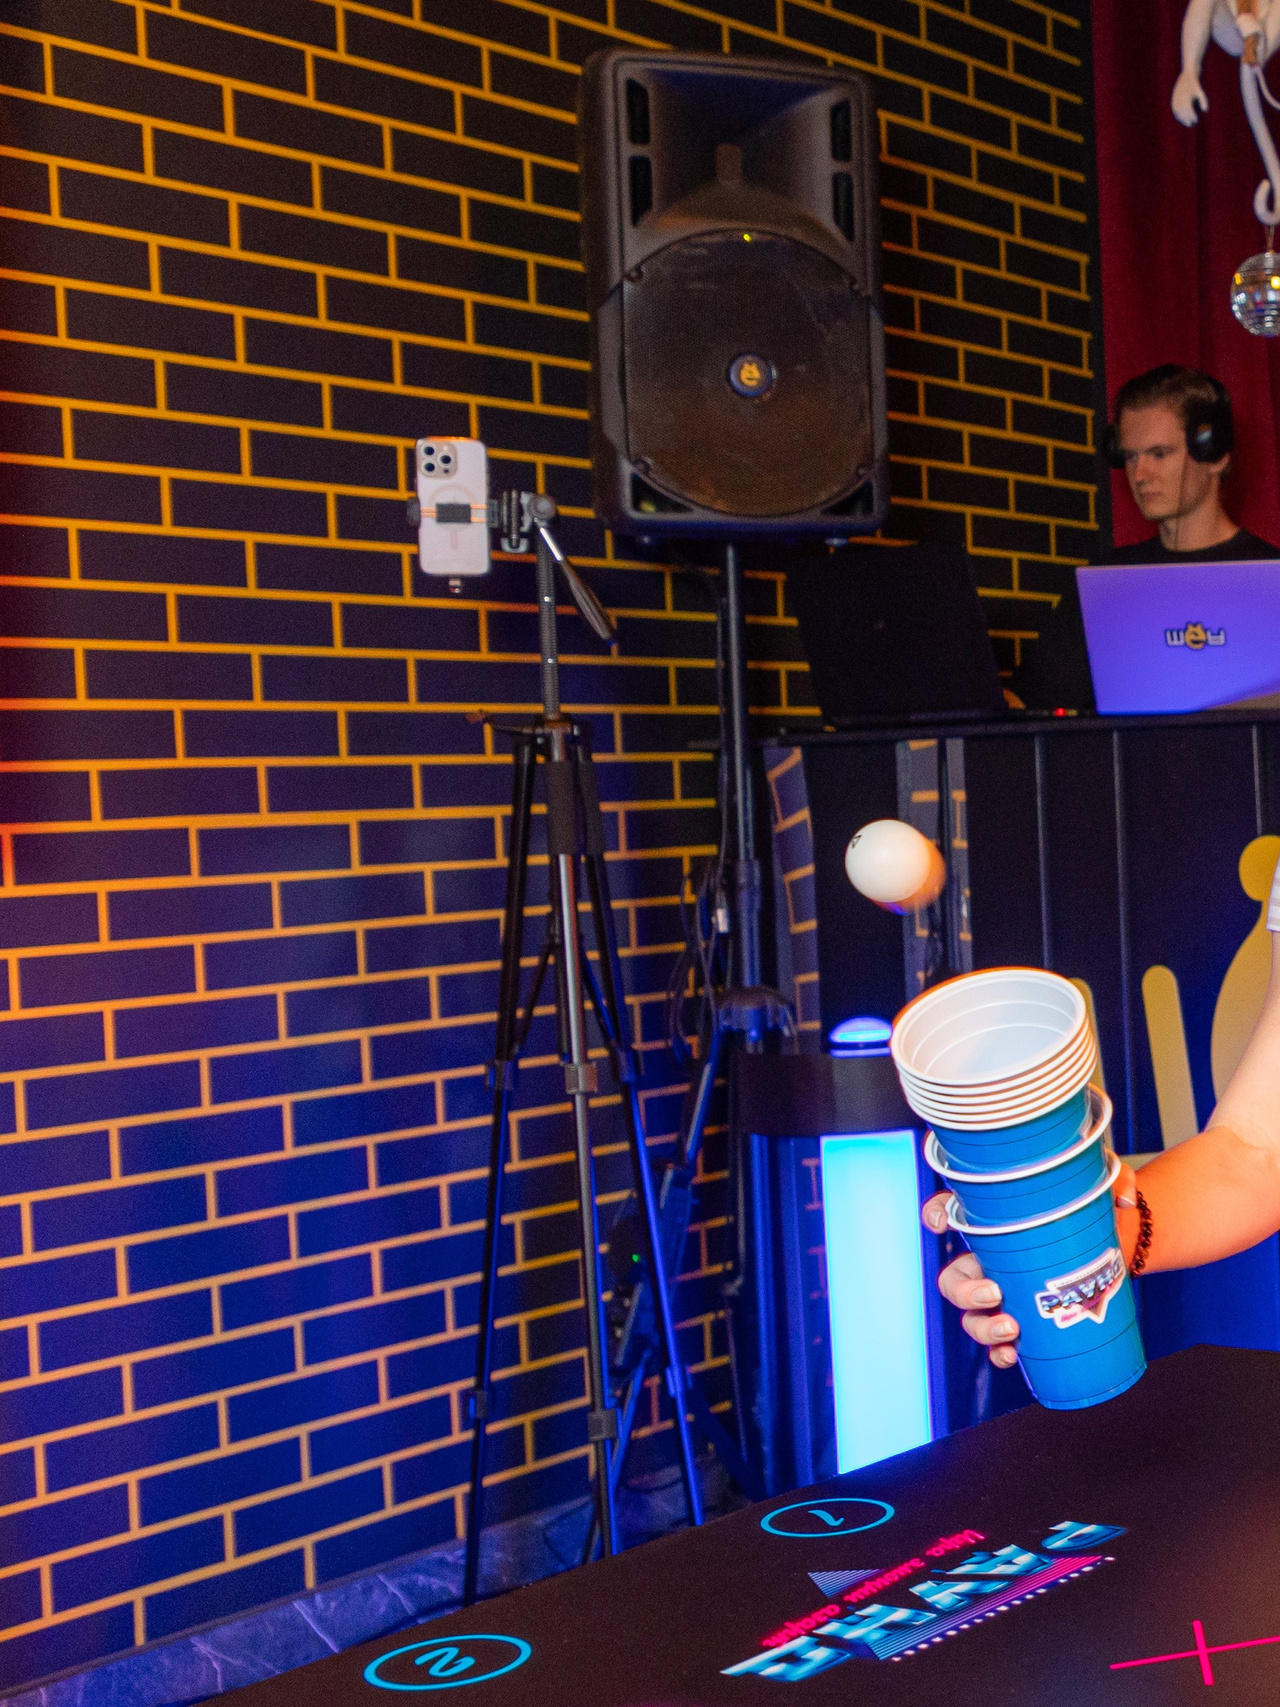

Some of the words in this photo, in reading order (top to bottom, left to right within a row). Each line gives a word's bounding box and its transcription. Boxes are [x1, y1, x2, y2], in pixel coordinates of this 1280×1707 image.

[808, 1509, 845, 1527] 1
[719, 1520, 1128, 1682] РАУНД
[414, 1646, 476, 1678] 2
